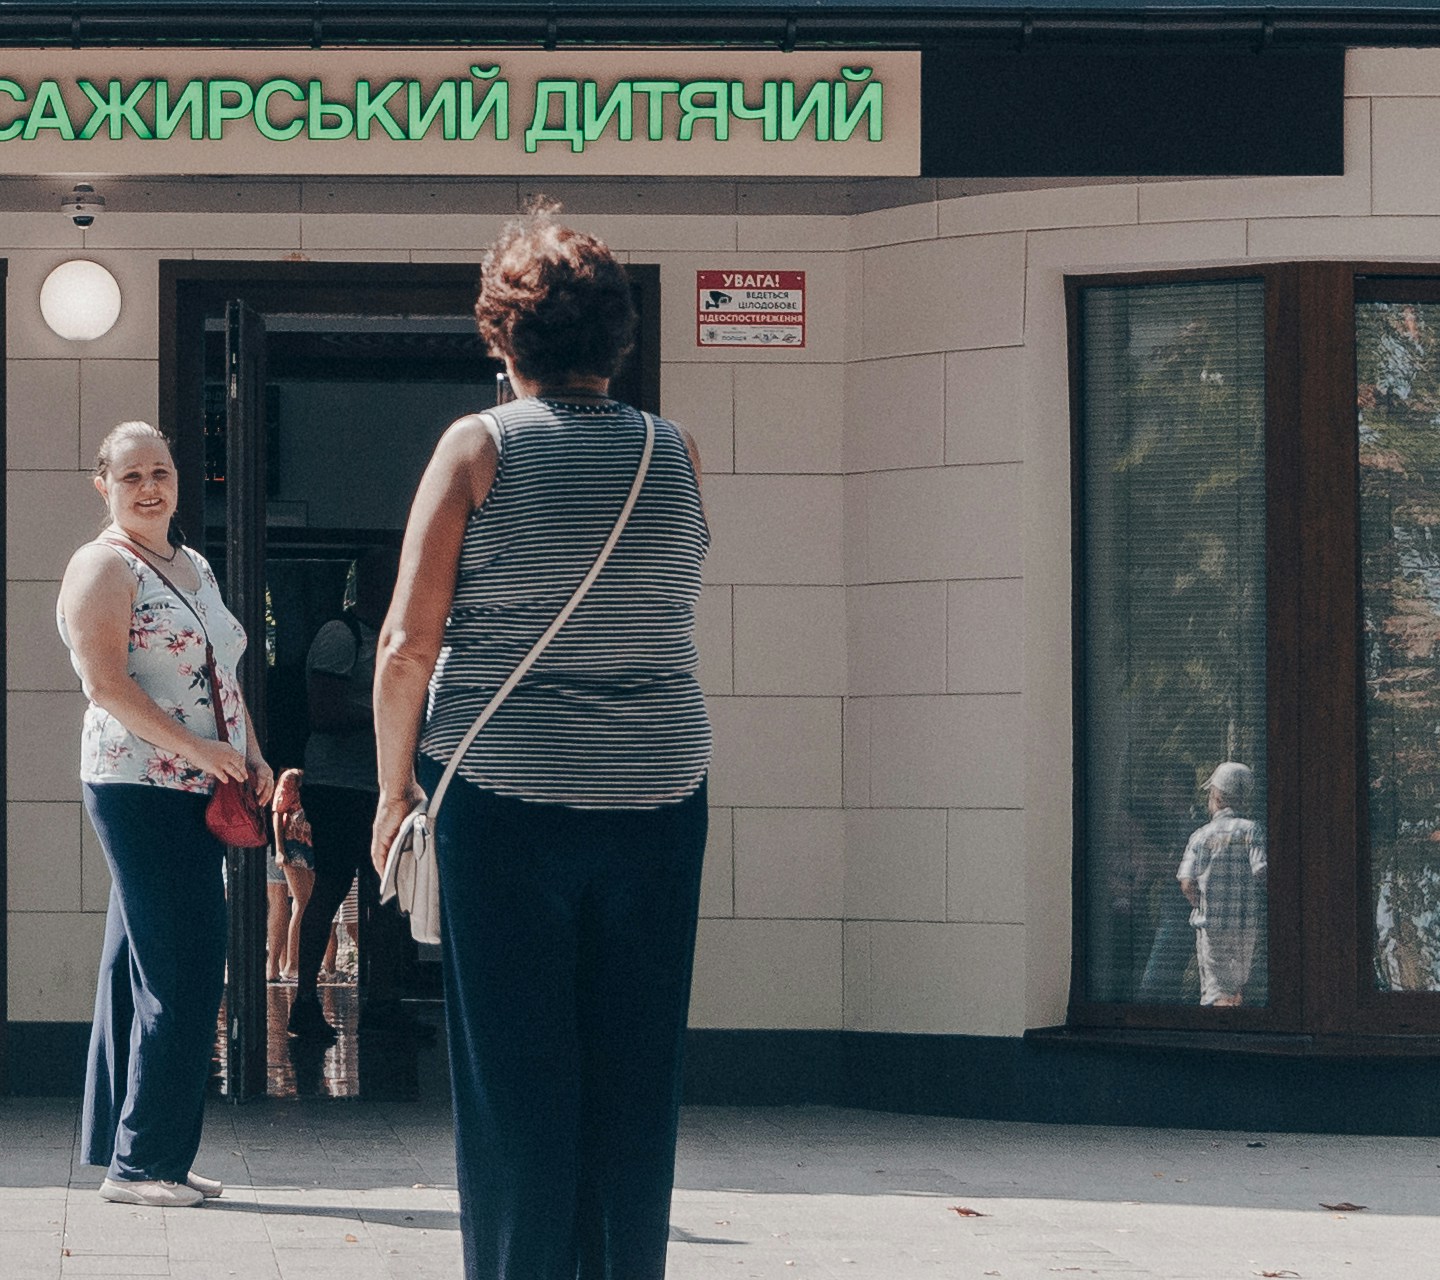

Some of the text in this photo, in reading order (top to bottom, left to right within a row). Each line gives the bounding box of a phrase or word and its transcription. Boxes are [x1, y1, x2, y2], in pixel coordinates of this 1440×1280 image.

[524, 66, 884, 154] ДИТЯЧИЙ
[722, 273, 780, 288] УВАГА!
[746, 291, 789, 300] ВЕДЕТЬСЯ
[699, 313, 803, 324] ВІДЕОСПОСТЕРЕЖЕННЯ
